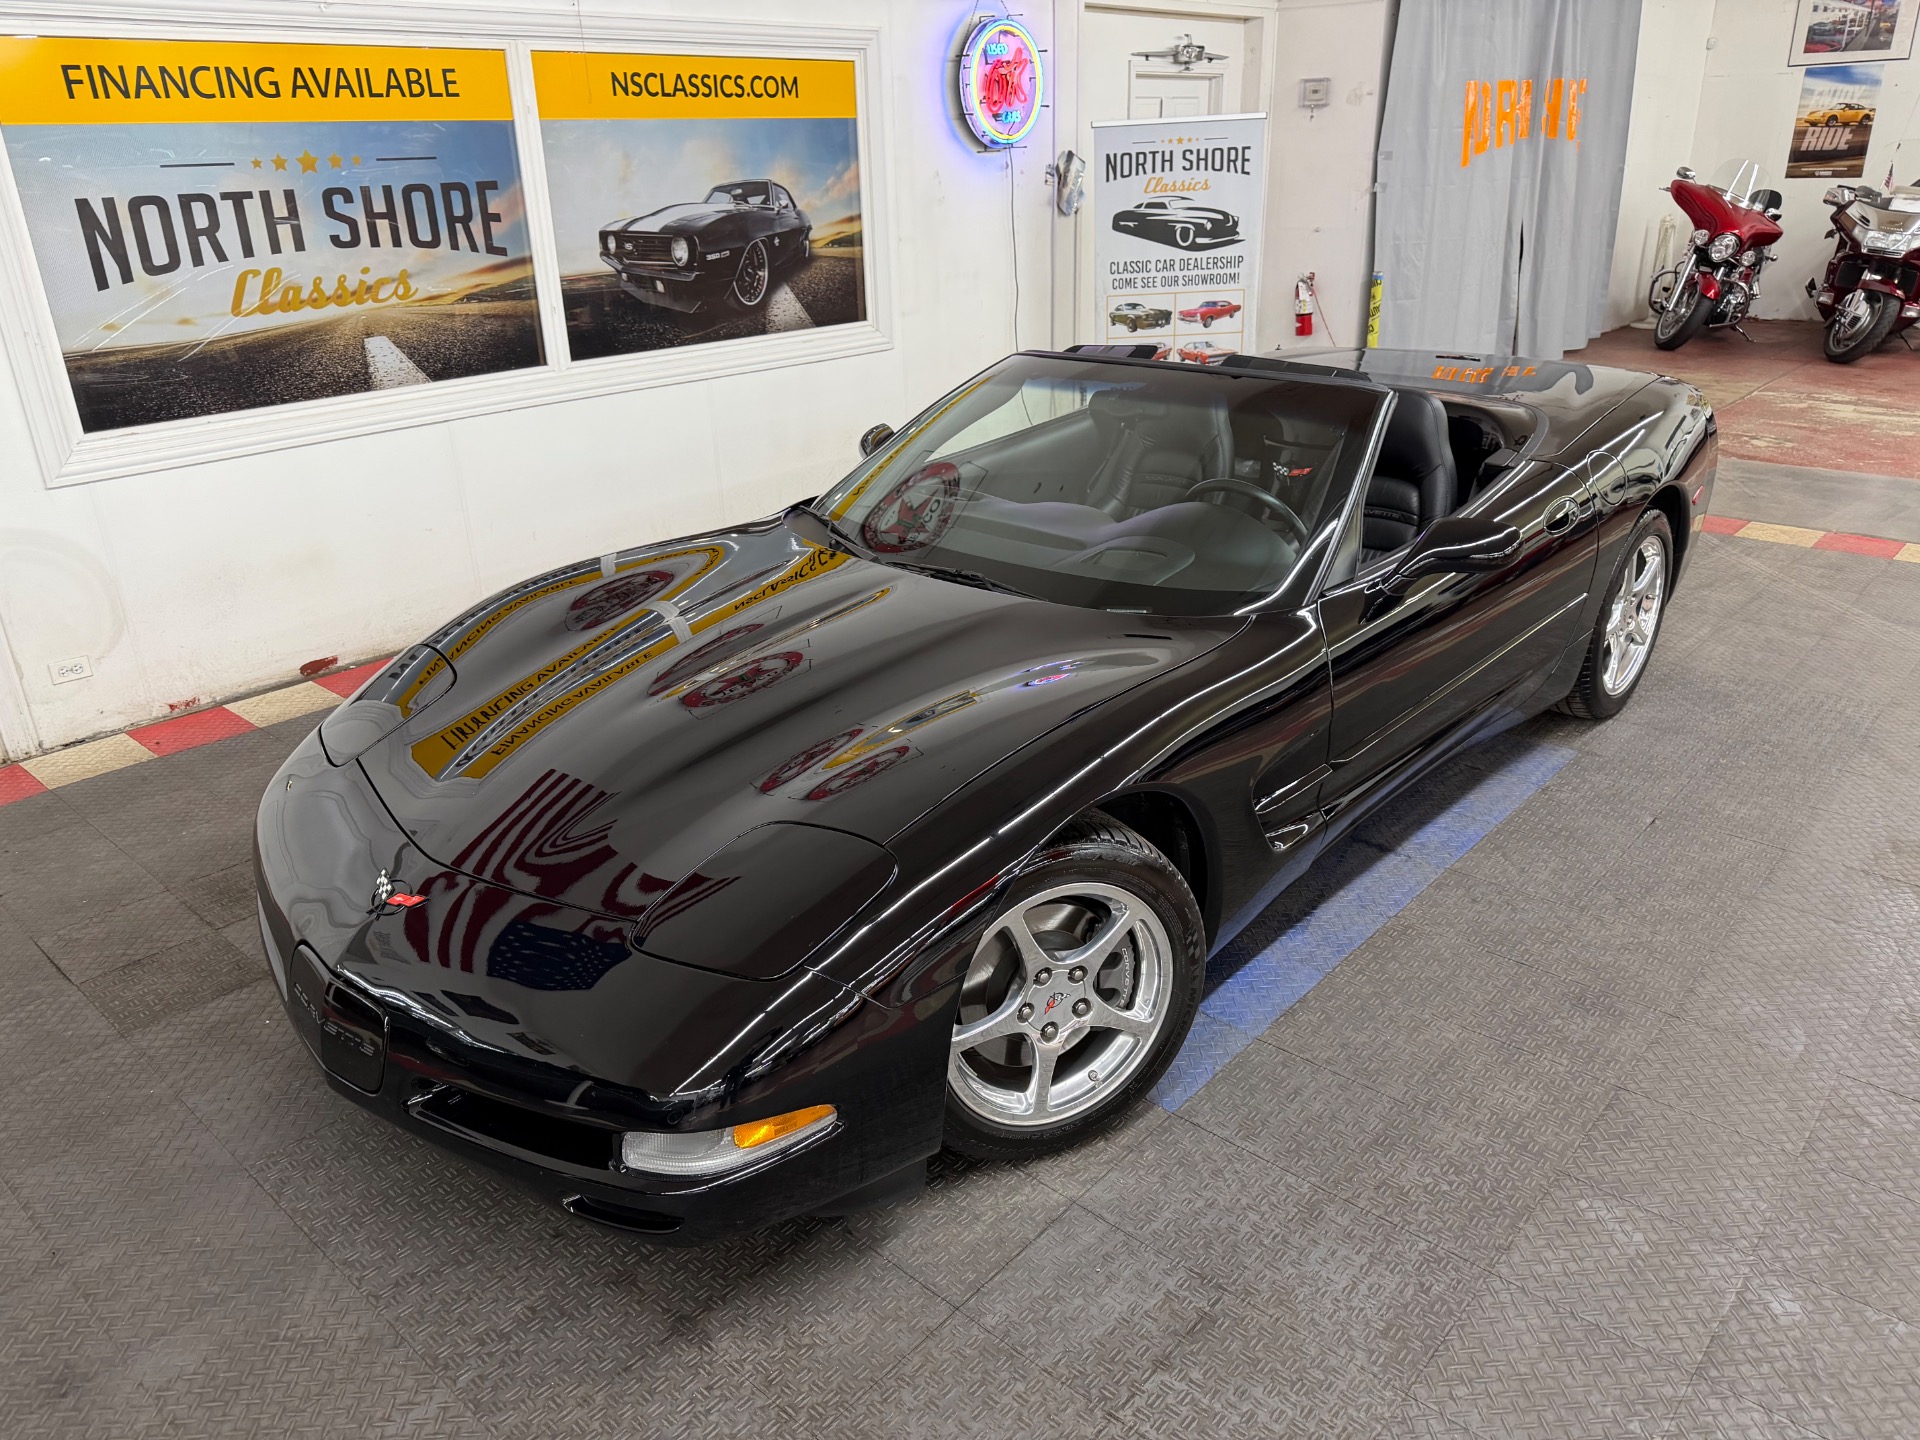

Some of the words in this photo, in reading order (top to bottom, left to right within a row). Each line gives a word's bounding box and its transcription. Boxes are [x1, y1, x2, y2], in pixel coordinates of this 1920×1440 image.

[60, 64, 281, 100] FINANCING
[290, 66, 461, 98] AVAILABLE
[610, 71, 799, 99] NSCLASSICS.COM
[986, 47, 1029, 114] OK
[1800, 126, 1856, 151] RIDE
[1105, 150, 1174, 183] NORTH
[1182, 146, 1252, 176] SHORE
[1143, 176, 1211, 194] Classics
[74, 188, 306, 293] NORTH
[321, 180, 508, 257] SHORE
[1109, 260, 1152, 275] CLASSIC
[1155, 258, 1176, 273] CAR
[1179, 255, 1244, 272] DEALERSHIP
[1112, 277, 1139, 290] COME
[1141, 276, 1158, 289] SEE
[1160, 275, 1179, 288] OUR
[1181, 272, 1240, 287] SHOWROOM!
[230, 266, 420, 319] Classics
